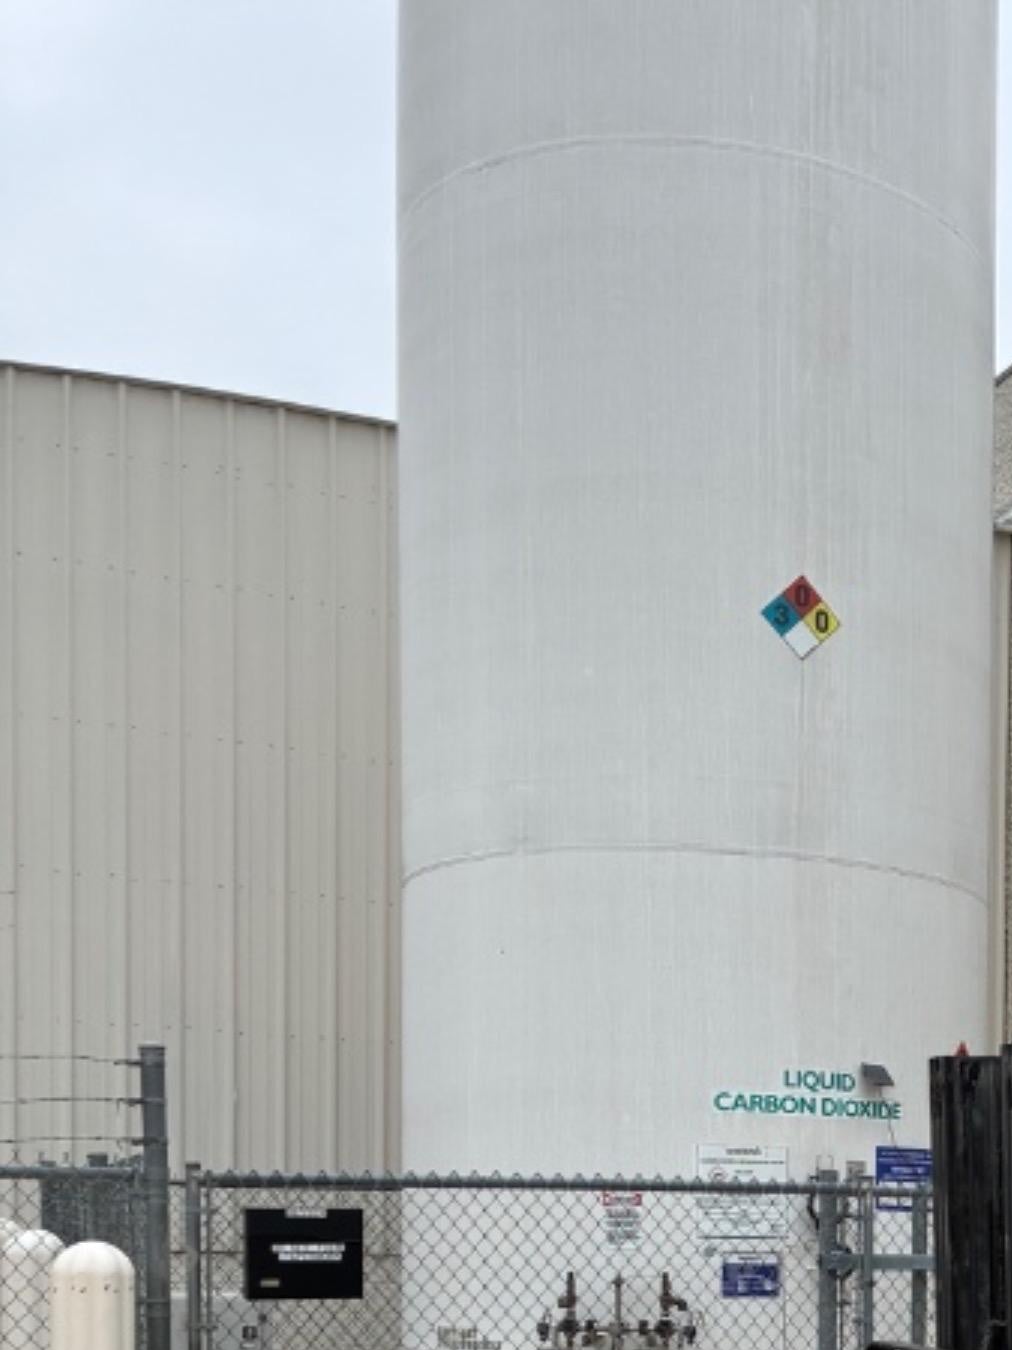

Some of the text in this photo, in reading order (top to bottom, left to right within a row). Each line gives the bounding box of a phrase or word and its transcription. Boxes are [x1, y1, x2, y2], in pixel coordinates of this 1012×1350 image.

[795, 585, 811, 608] 0
[774, 604, 789, 625] 3
[815, 610, 829, 633] 0
[783, 1069, 856, 1092] LIQUID
[713, 1091, 901, 1120] CARBON DIOXIDE
